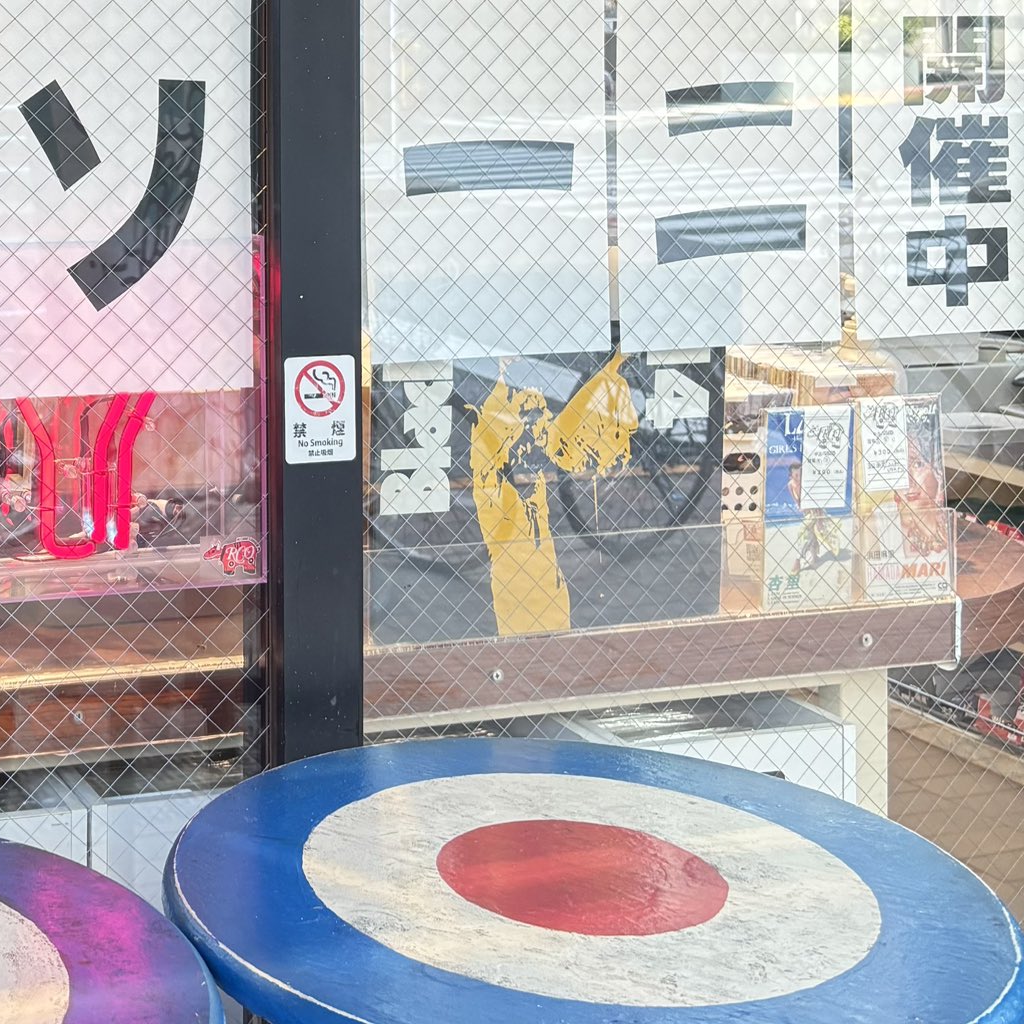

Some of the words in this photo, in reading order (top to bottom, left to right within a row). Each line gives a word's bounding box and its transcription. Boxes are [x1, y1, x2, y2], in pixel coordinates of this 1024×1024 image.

[898, 16, 1011, 307] 開催中
[298, 439, 309, 448] No
[310, 438, 343, 448] Smoking
[901, 561, 947, 579] MARI
